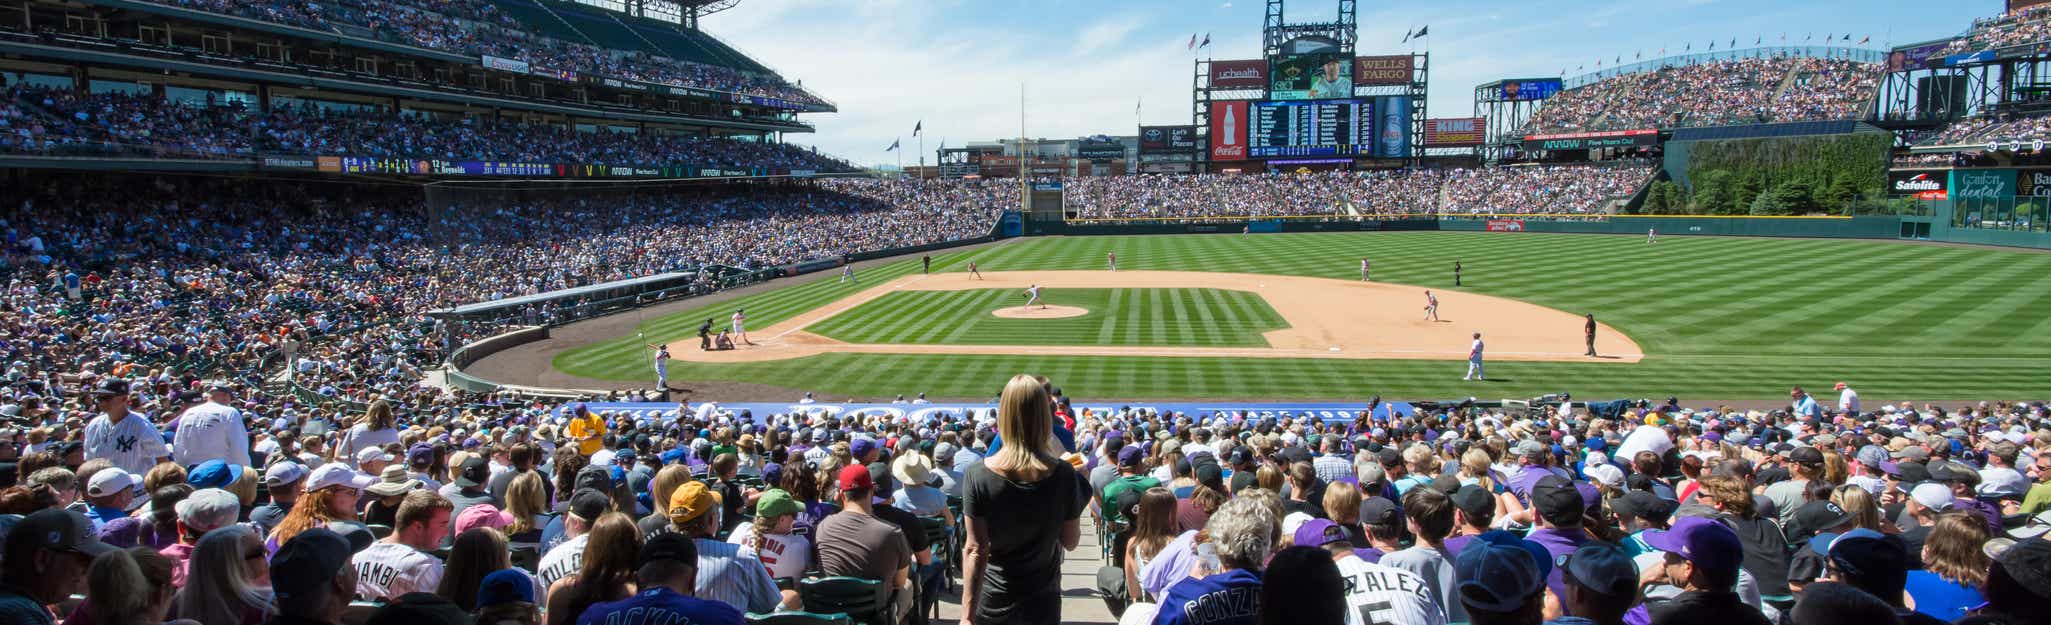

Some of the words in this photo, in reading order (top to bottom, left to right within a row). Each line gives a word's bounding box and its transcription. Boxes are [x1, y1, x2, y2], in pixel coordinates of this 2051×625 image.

[1362, 61, 1406, 69] WELLS
[1219, 67, 1259, 78] uchealth
[1363, 70, 1405, 79] FARGO
[1437, 120, 1474, 132] KING
[1543, 140, 1580, 149] ARROW
[442, 167, 466, 175] Reynolds
[1896, 179, 1940, 190] Safelite
[1960, 181, 2004, 199] dental
[741, 535, 786, 556] PEROIA
